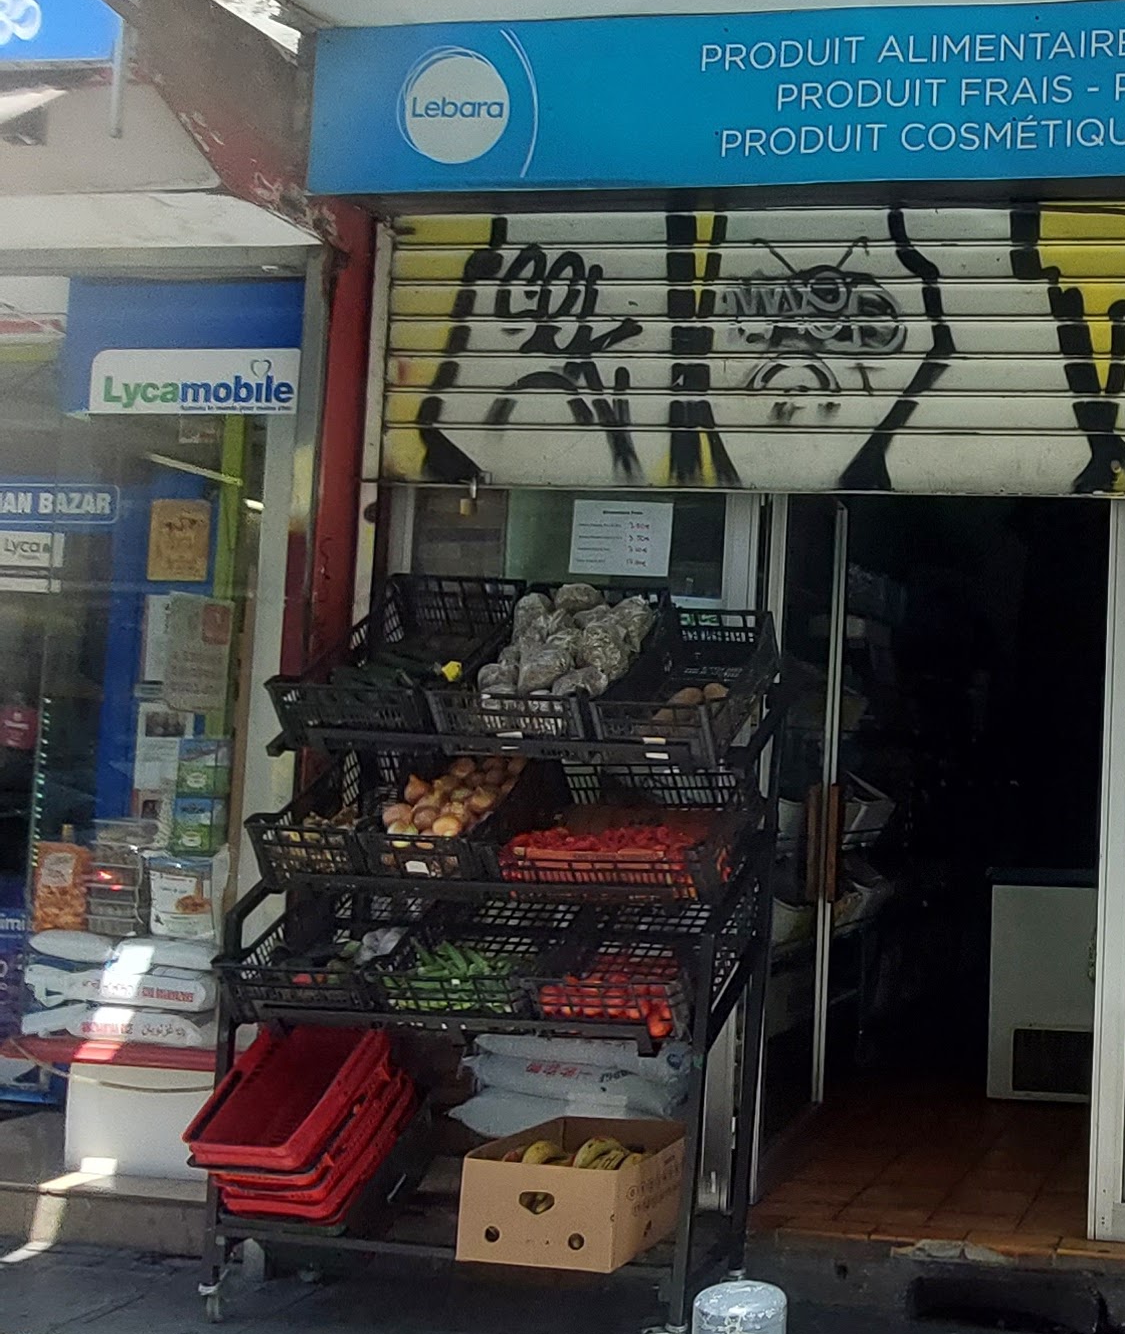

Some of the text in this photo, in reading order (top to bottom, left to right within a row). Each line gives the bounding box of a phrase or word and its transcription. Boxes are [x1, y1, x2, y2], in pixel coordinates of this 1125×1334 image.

[700, 36, 865, 72] PRODUIT
[411, 95, 505, 120] Lebara
[776, 76, 947, 113] PRODUIT
[960, 74, 1073, 106] FRAIS
[720, 122, 888, 159] PRODUIT
[103, 374, 295, 408] Lycamobile
[39, 492, 112, 515] BAZAR
